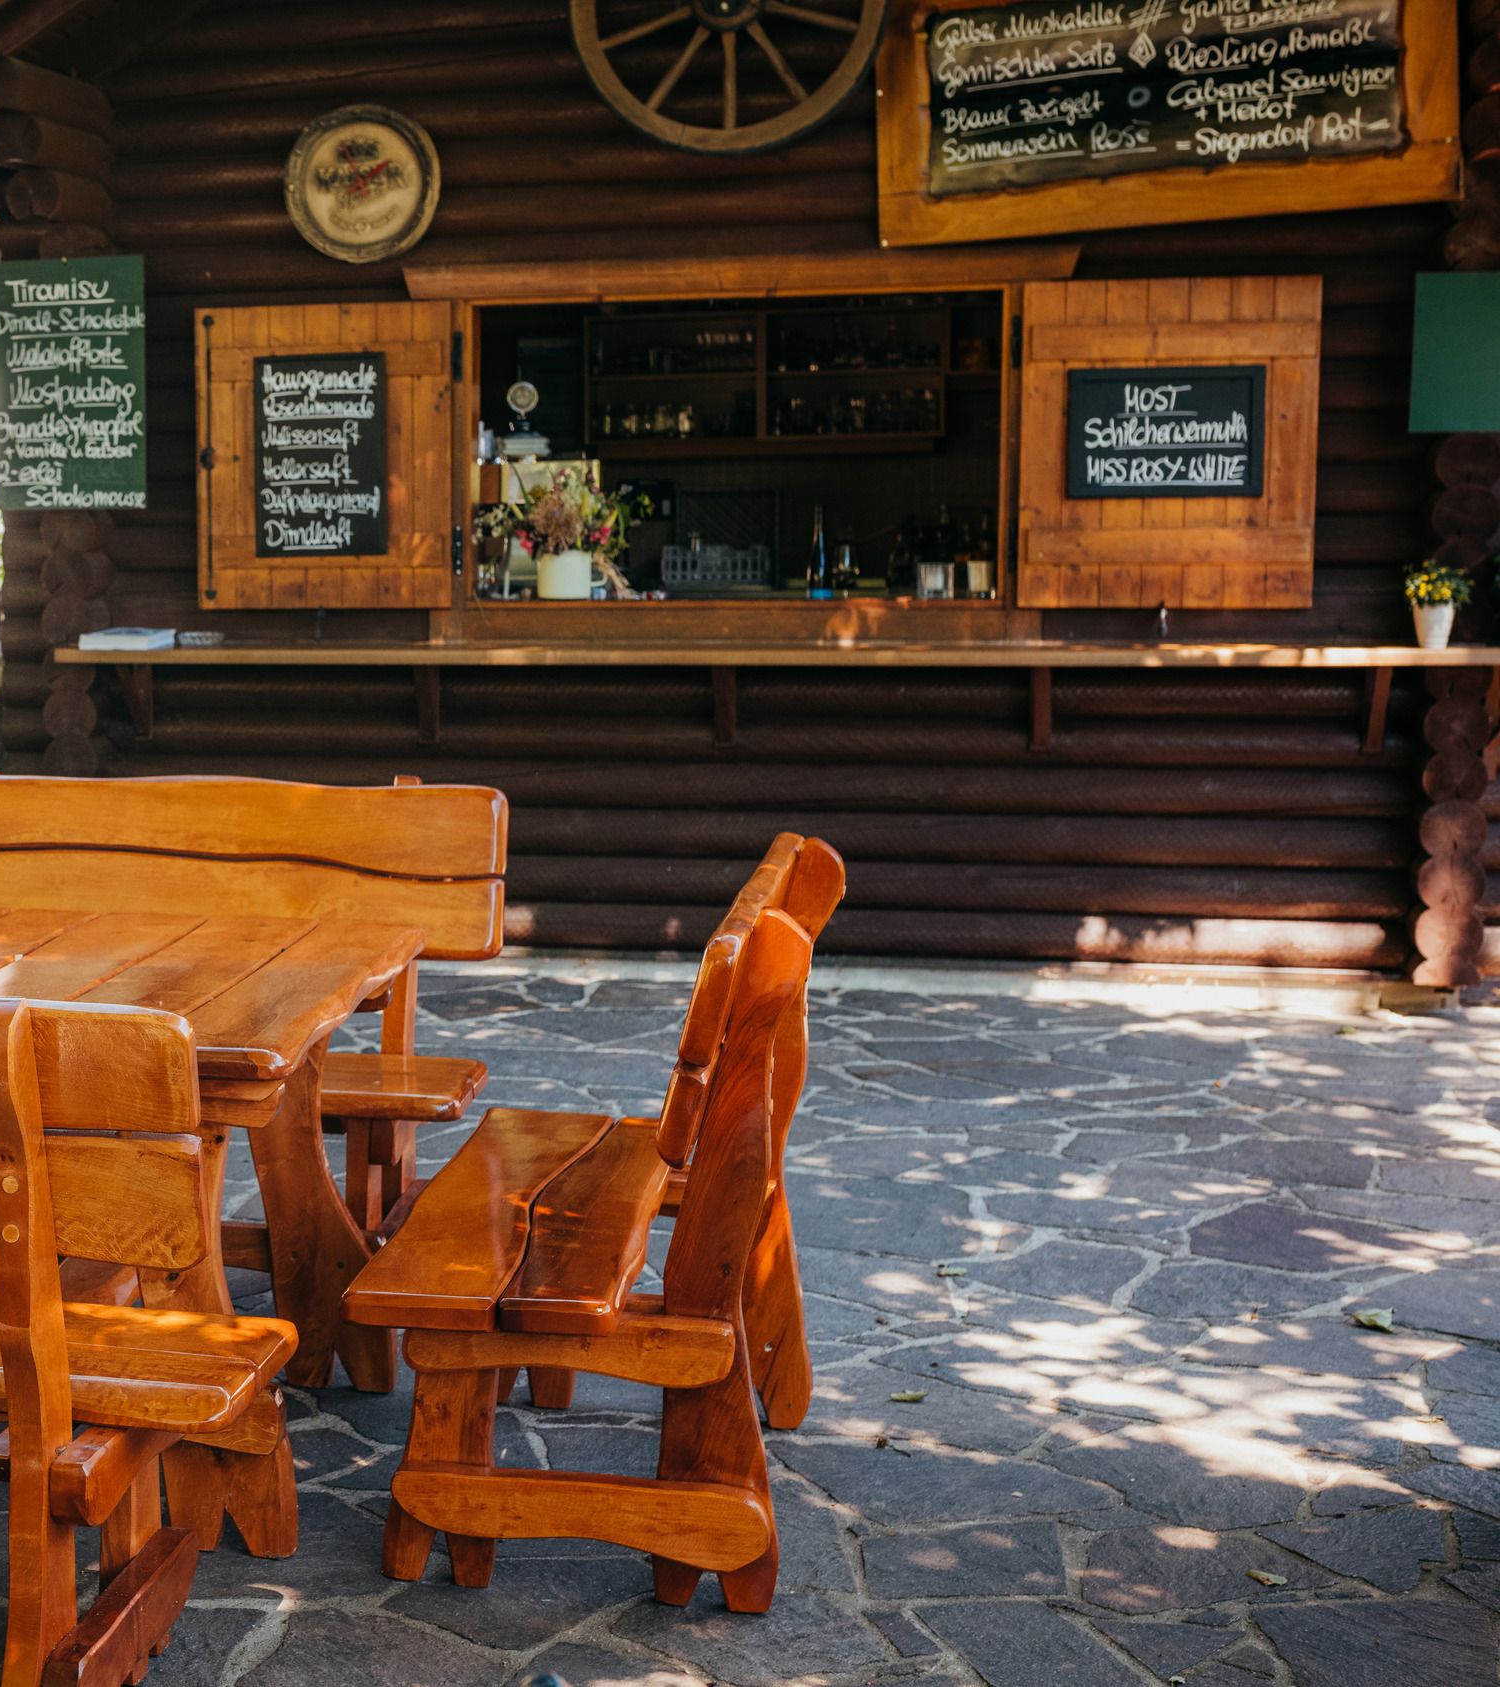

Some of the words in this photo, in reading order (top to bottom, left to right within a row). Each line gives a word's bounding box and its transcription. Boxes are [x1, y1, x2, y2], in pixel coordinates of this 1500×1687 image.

[935, 17, 998, 50] Gelber
[1003, 2, 1125, 38] Muskateller
[937, 48, 1061, 98] Gemischter
[1066, 39, 1117, 68] Satz
[1165, 35, 1278, 72] Riesling
[1166, 69, 1275, 107] Cabernet
[1280, 64, 1397, 97] Sauvignon
[940, 104, 1012, 133] Blauer
[1019, 89, 1105, 126] Zweigelt
[1217, 93, 1297, 124] Merlot
[941, 128, 1079, 165] Sommerwein
[1194, 114, 1315, 163] Siegendorf
[1322, 106, 1364, 143] Rot
[4, 277, 109, 302] Tiramisu
[9, 374, 137, 418] Mostpudding
[1124, 383, 1192, 414] MOST
[263, 453, 352, 488] Hollersaft
[1086, 455, 1128, 485] MISS
